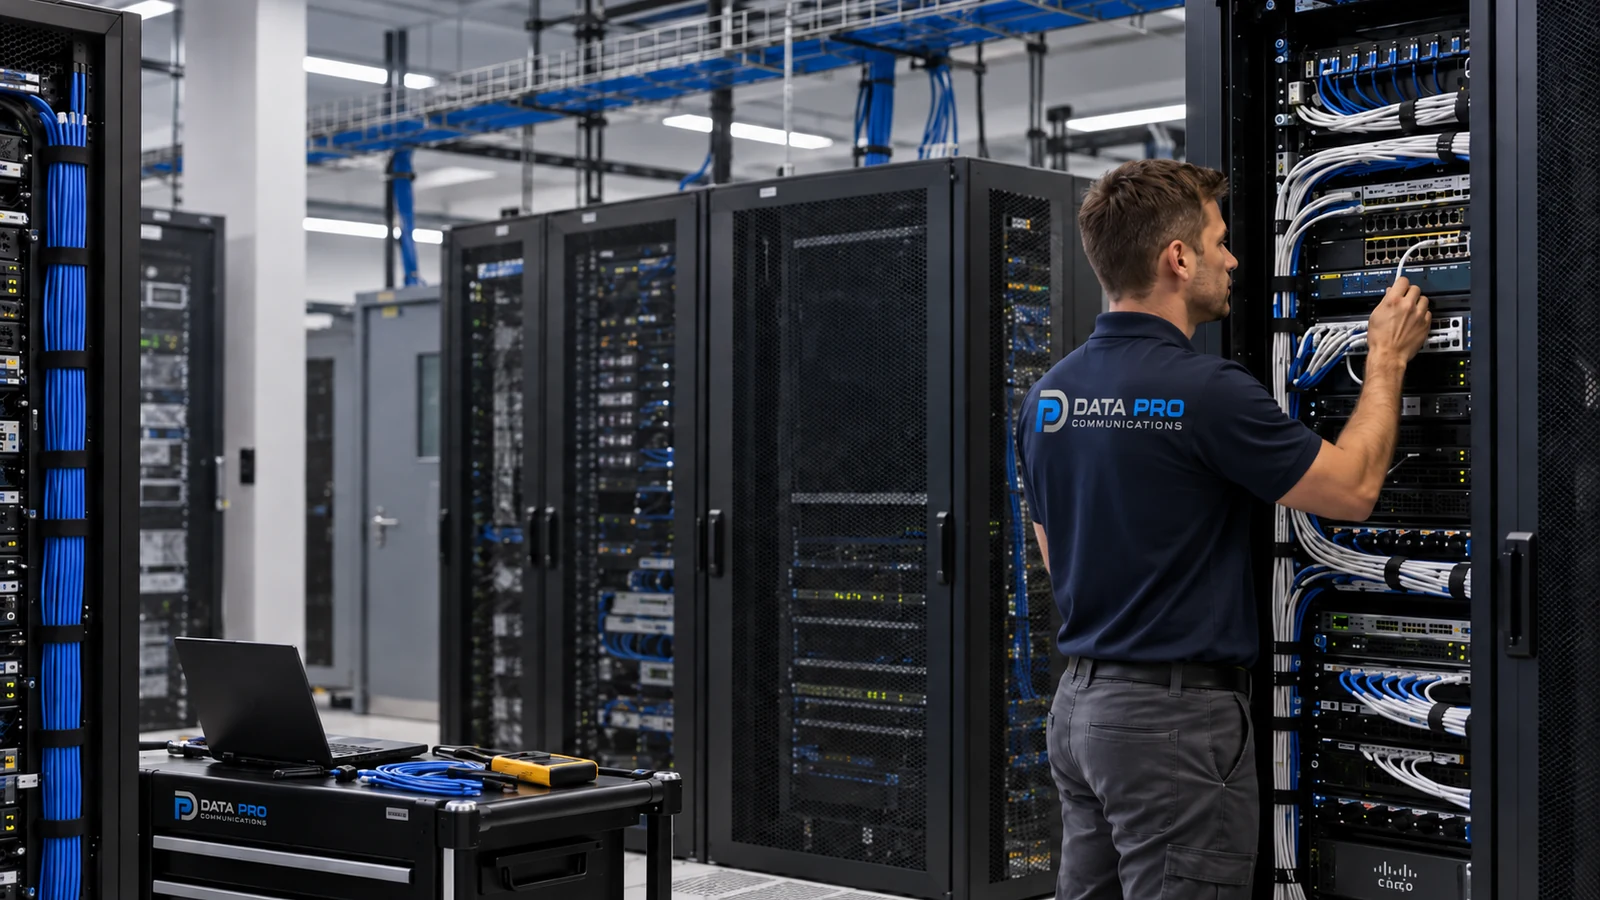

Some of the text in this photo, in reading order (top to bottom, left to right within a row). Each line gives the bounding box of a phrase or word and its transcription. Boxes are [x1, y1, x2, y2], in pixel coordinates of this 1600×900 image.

[1073, 398, 1185, 418] DATA PRO
[1071, 419, 1183, 431] COMMUNICATIONS
[200, 799, 267, 818] DATA PRO
[200, 813, 267, 827] COMMUNICATIONS
